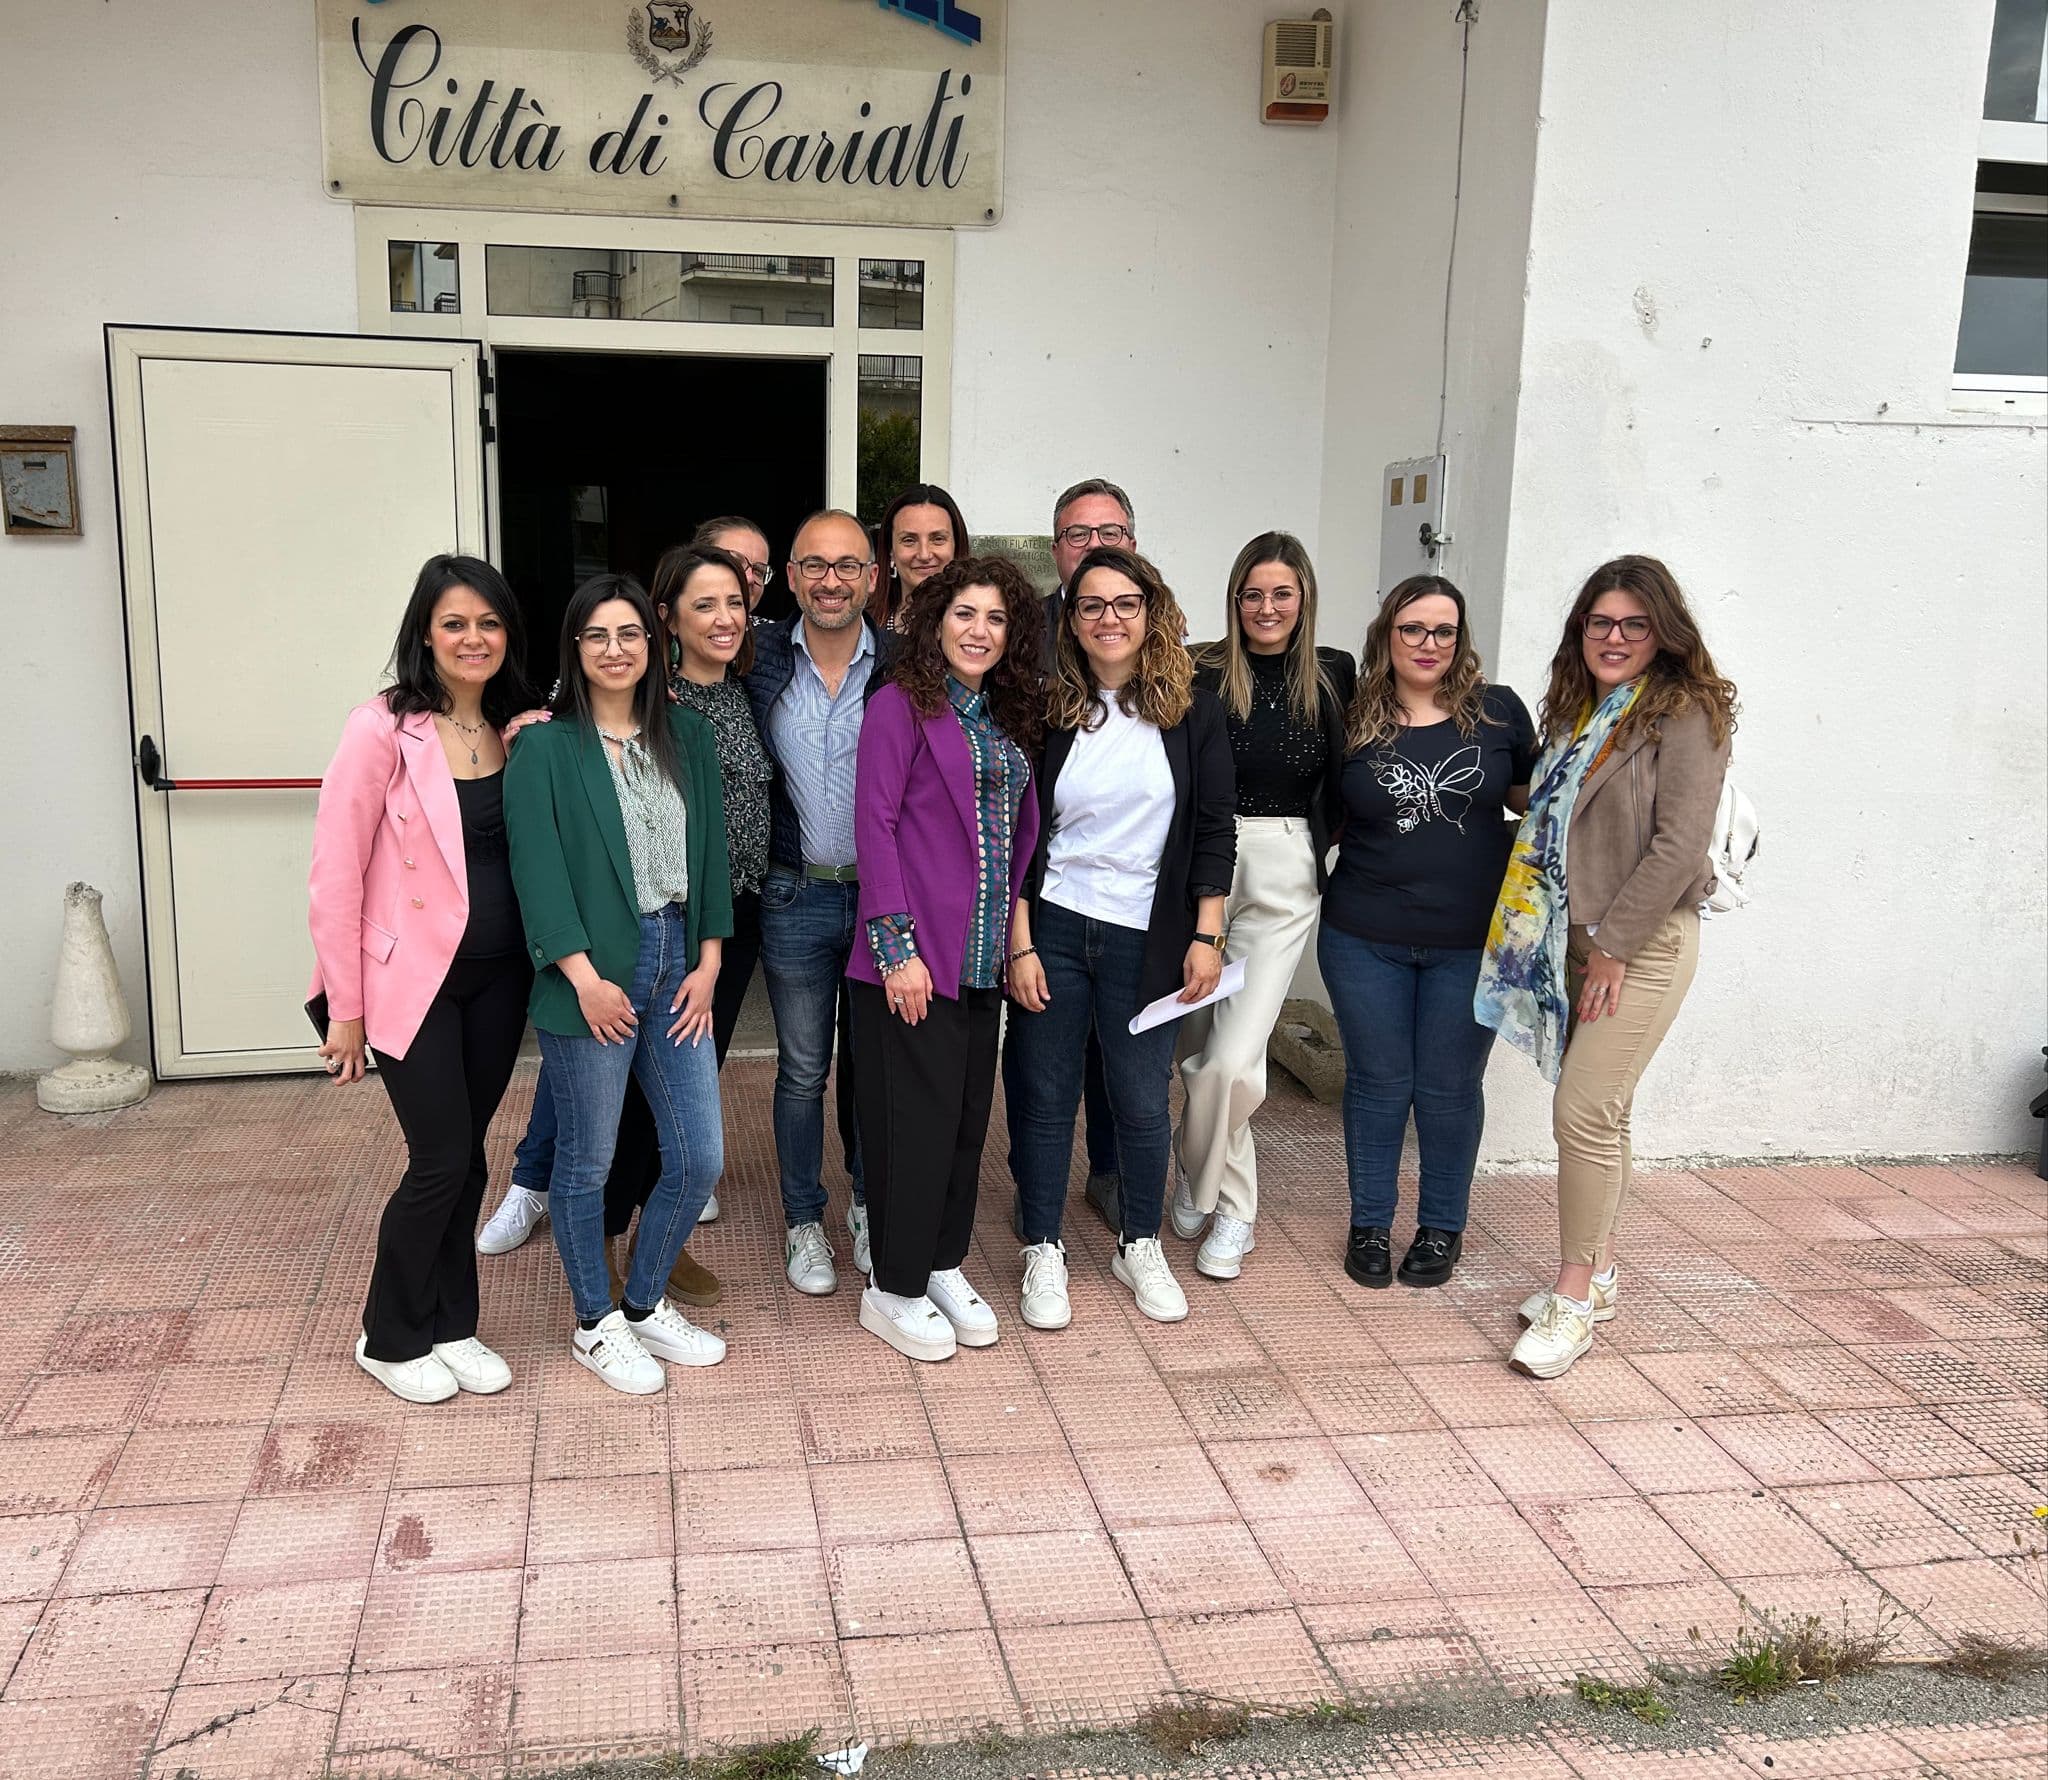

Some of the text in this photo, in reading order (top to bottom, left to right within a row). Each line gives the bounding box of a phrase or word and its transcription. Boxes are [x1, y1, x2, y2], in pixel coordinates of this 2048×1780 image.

[352, 17, 973, 190] Città di Cariati
